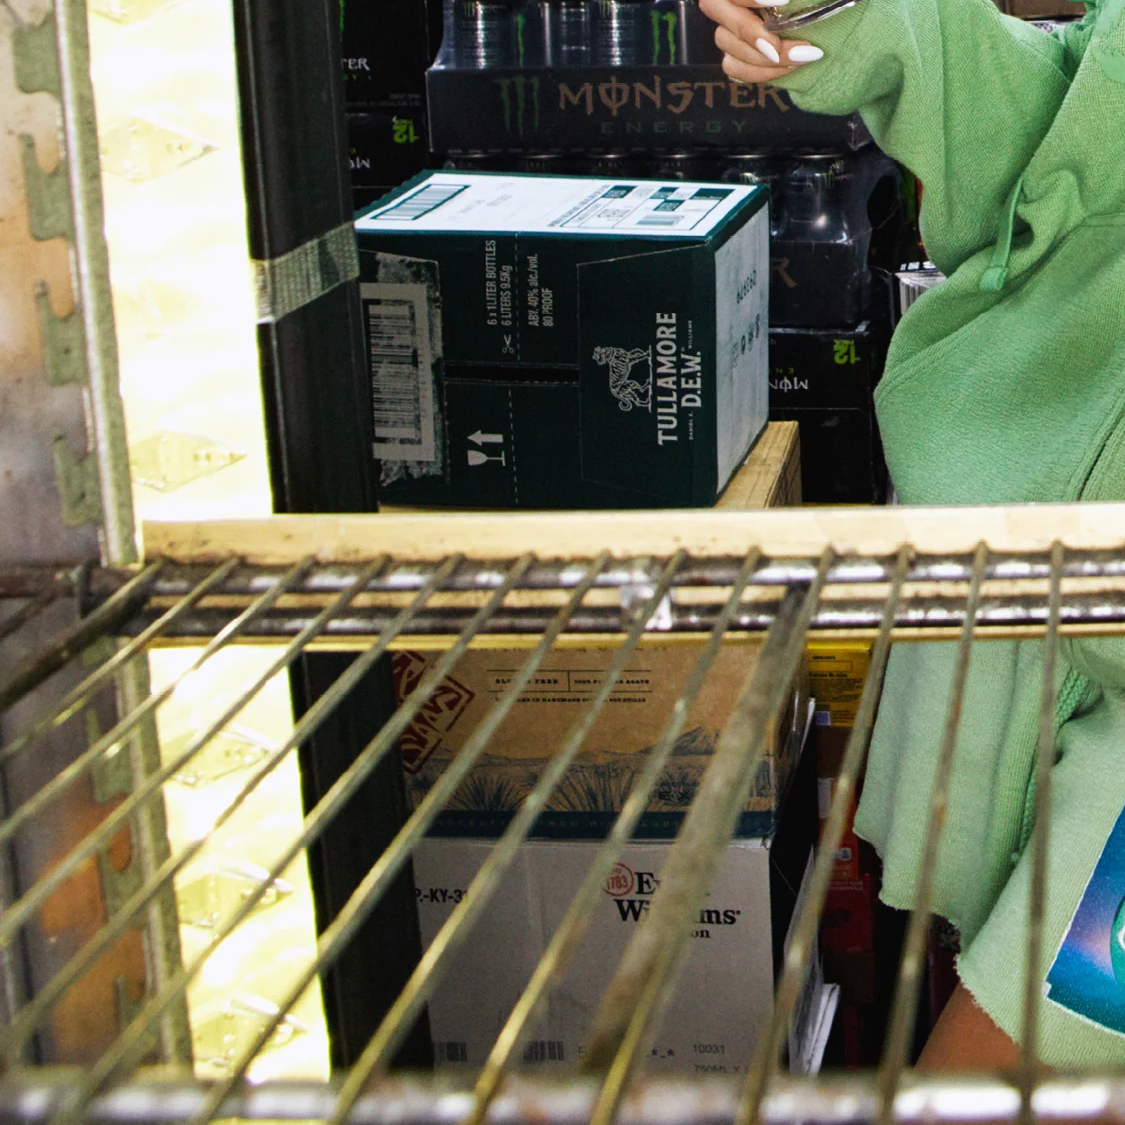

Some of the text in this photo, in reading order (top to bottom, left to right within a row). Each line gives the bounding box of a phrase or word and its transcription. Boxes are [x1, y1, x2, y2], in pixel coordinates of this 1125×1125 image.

[558, 75, 791, 117] MONSTER
[392, 119, 419, 143] 12
[600, 121, 748, 134] ENERGY
[485, 240, 497, 279] BOTTLES
[500, 265, 513, 289] 9.5Kg
[500, 290, 512, 318] LITERS
[527, 288, 539, 307] 40%
[541, 287, 554, 326] 80 PROOF
[833, 339, 861, 364] 12
[655, 312, 678, 446] TULLAMORE
[680, 351, 702, 407] D.E.W.
[692, 1043, 726, 1054] 10031
